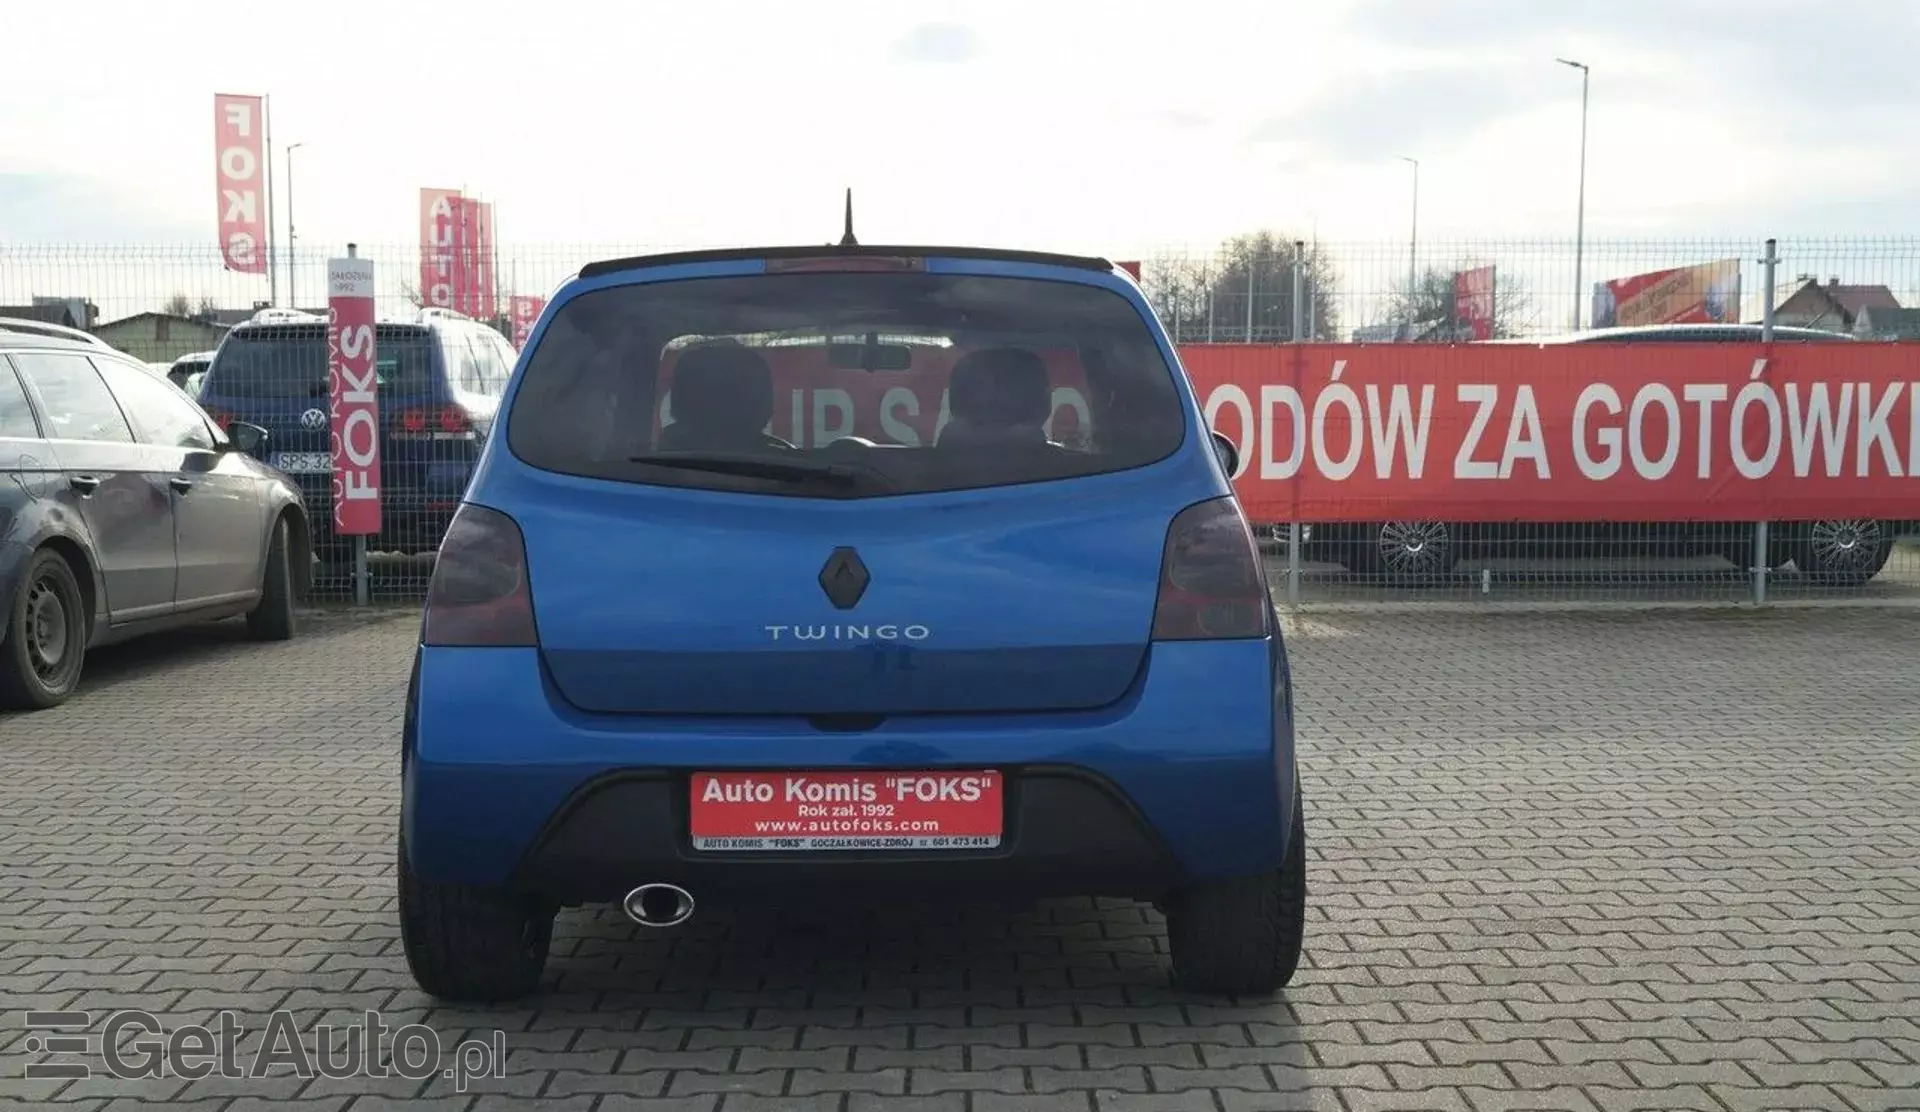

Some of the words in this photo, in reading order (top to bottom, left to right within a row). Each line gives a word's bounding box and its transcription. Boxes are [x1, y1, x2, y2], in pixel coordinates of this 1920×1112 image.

[340, 324, 378, 500] FOKS
[1454, 384, 1551, 480] ZA
[765, 625, 930, 640] TWINGO
[703, 778, 774, 802] Auto
[785, 778, 877, 802] Komis
[886, 777, 991, 802] "FOKS"
[798, 805, 828, 817] Rok
[860, 804, 895, 817] 1992
[755, 818, 939, 832] www.autofoks.com
[703, 838, 729, 848] AUTO
[731, 838, 764, 848] KOMIS
[972, 837, 989, 846] 414
